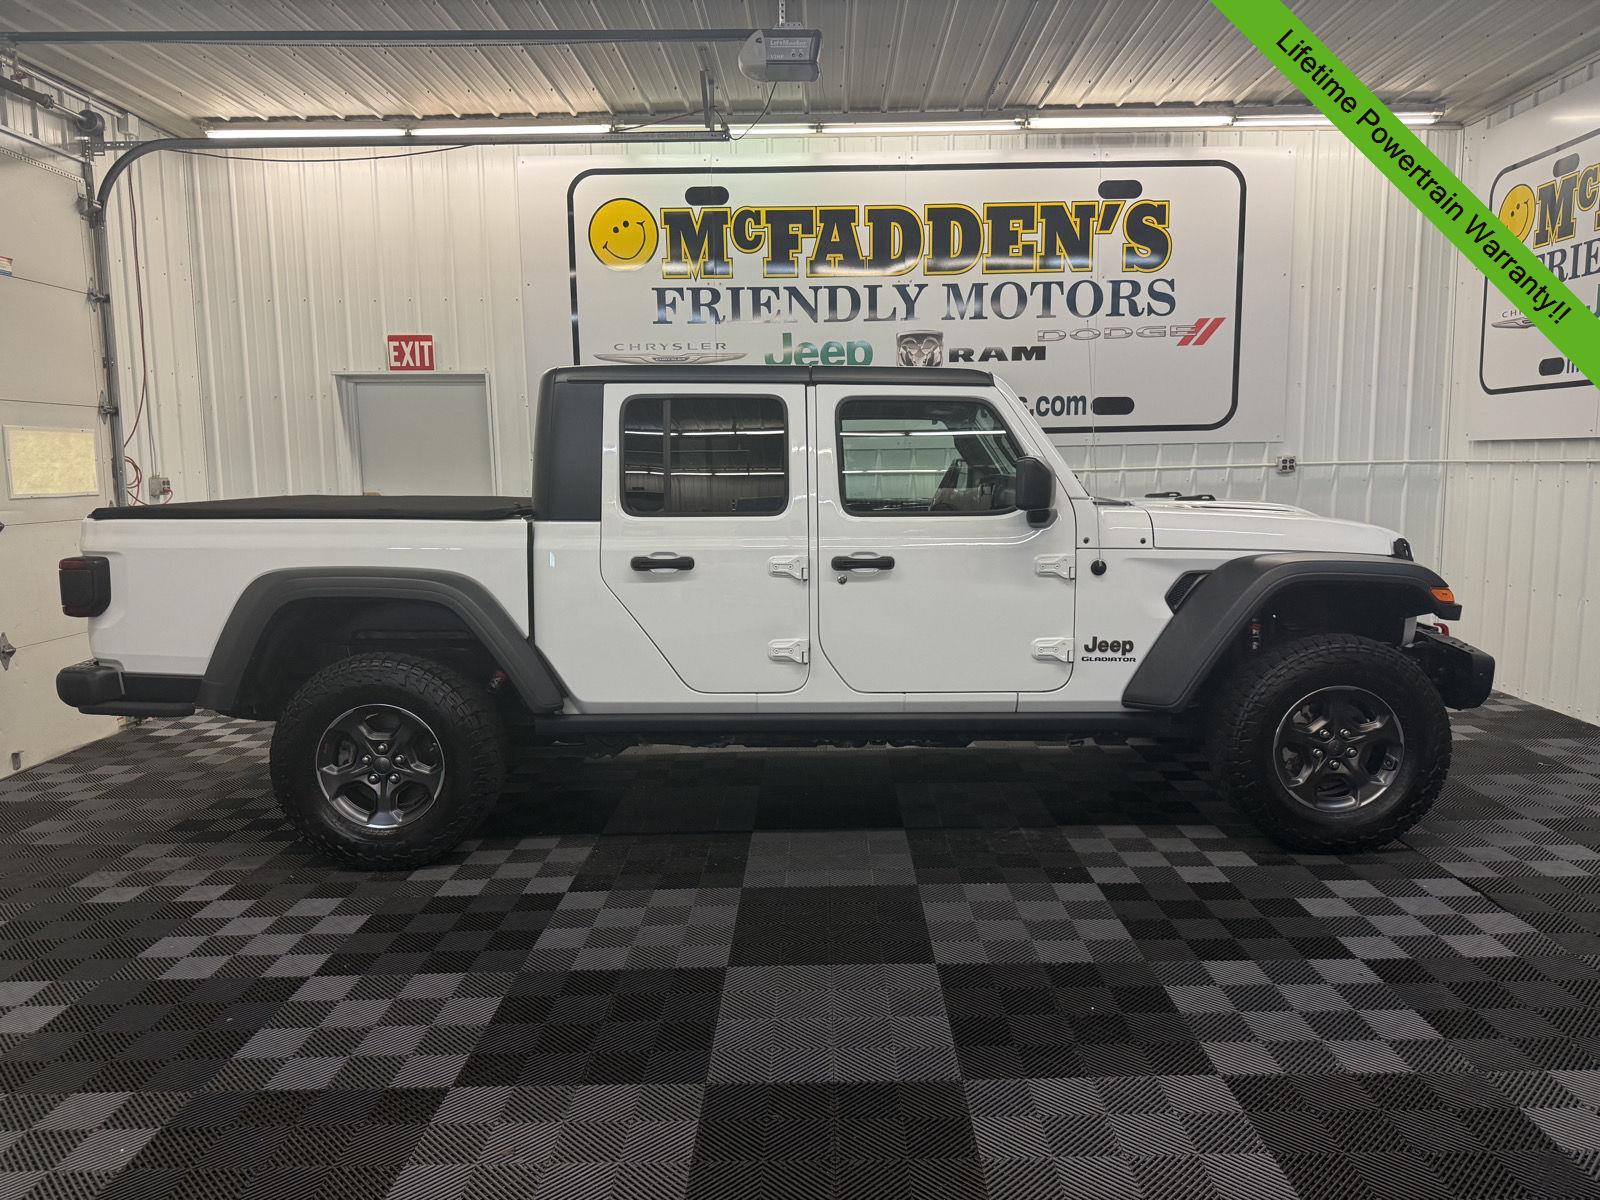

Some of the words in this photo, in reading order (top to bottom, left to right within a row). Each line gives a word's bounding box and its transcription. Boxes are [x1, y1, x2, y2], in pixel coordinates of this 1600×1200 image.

[651, 284, 928, 325] FRIENDLY
[941, 278, 1177, 321] MOTORS
[1037, 324, 1199, 342] DODGE
[389, 341, 433, 367] EXIT
[613, 342, 727, 351] CHRYSLER
[764, 332, 874, 366] Jeep
[948, 345, 1047, 363] RAM
[1083, 636, 1134, 656] Jeep
